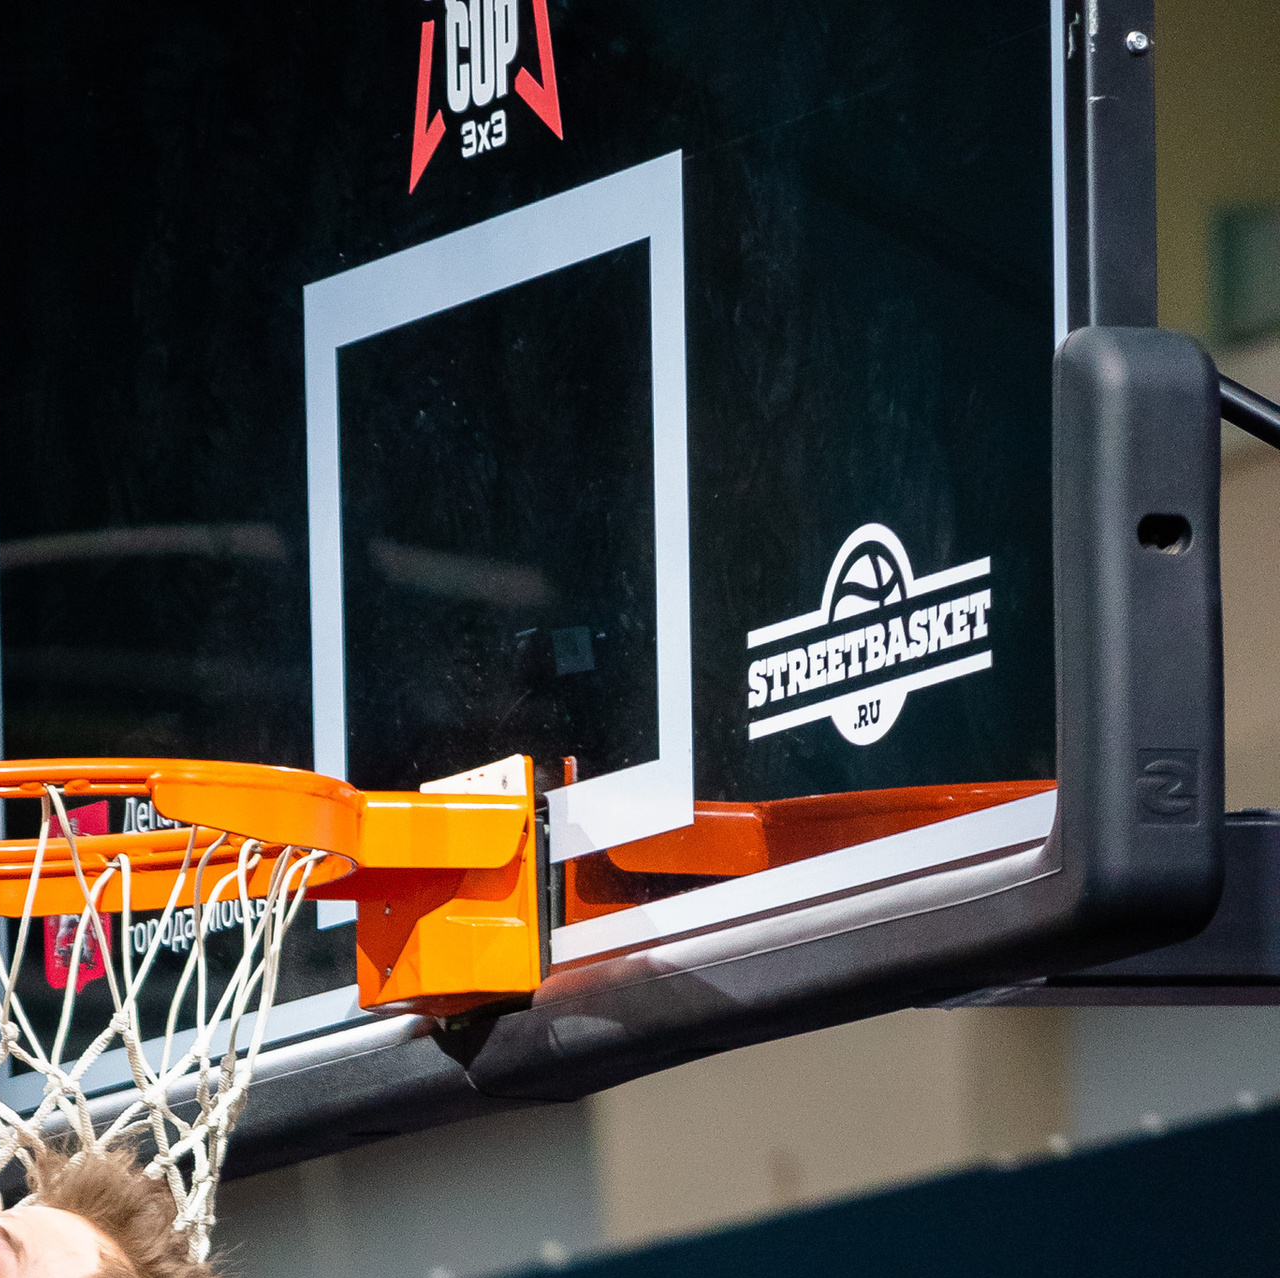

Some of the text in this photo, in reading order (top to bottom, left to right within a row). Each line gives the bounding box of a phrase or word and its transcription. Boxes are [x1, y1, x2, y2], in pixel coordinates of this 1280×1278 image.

[445, 0, 519, 113] CUP
[460, 109, 507, 159] 3x3
[747, 588, 992, 709] STREETBASKET
[853, 699, 881, 729] .RU
